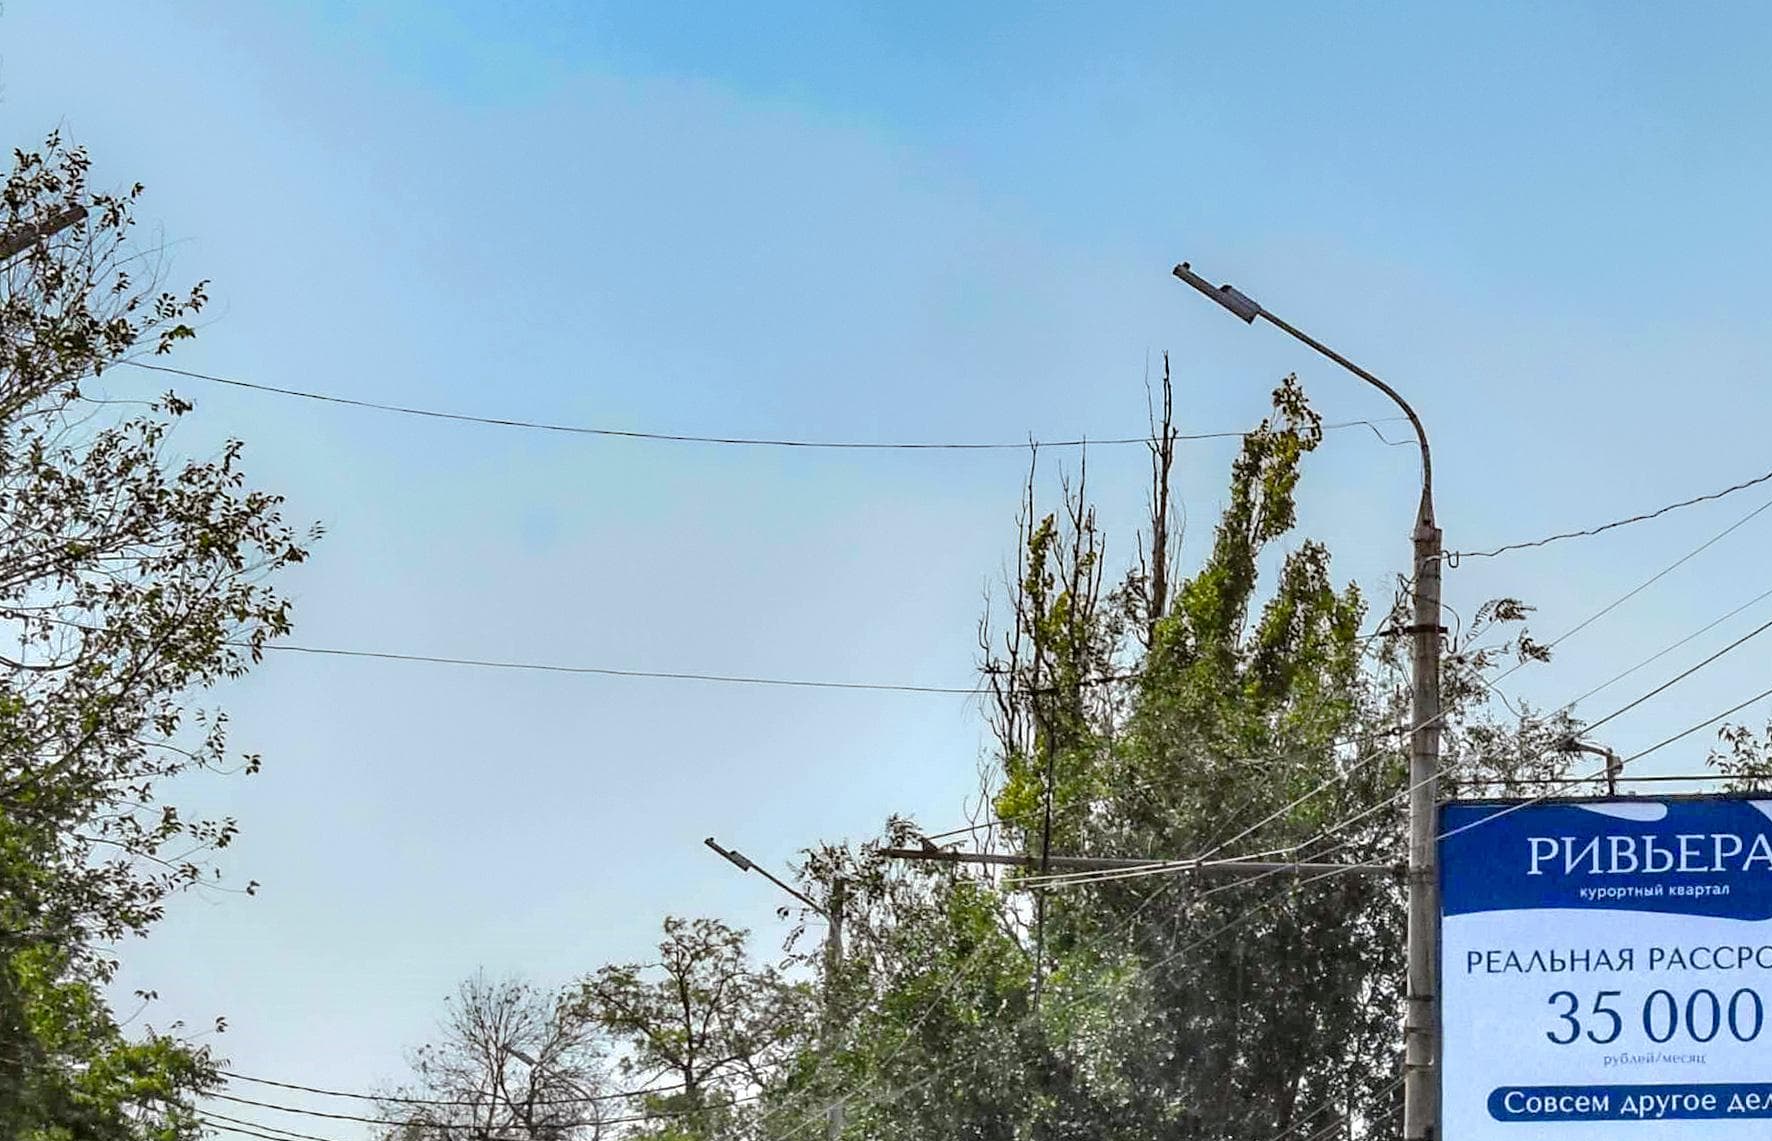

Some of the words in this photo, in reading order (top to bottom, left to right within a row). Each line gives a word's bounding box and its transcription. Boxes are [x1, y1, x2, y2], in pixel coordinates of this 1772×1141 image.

[1580, 883, 1664, 899] курортный
[1669, 883, 1731, 898] квартал
[1467, 947, 1635, 974] РЕАЛЬНАЯ
[1546, 990, 1623, 1046] 35
[1642, 988, 1764, 1044] 000
[1603, 1051, 1706, 1068] рублей/месяц
[1503, 1090, 1609, 1114] Совсем
[1620, 1092, 1717, 1119] другое
